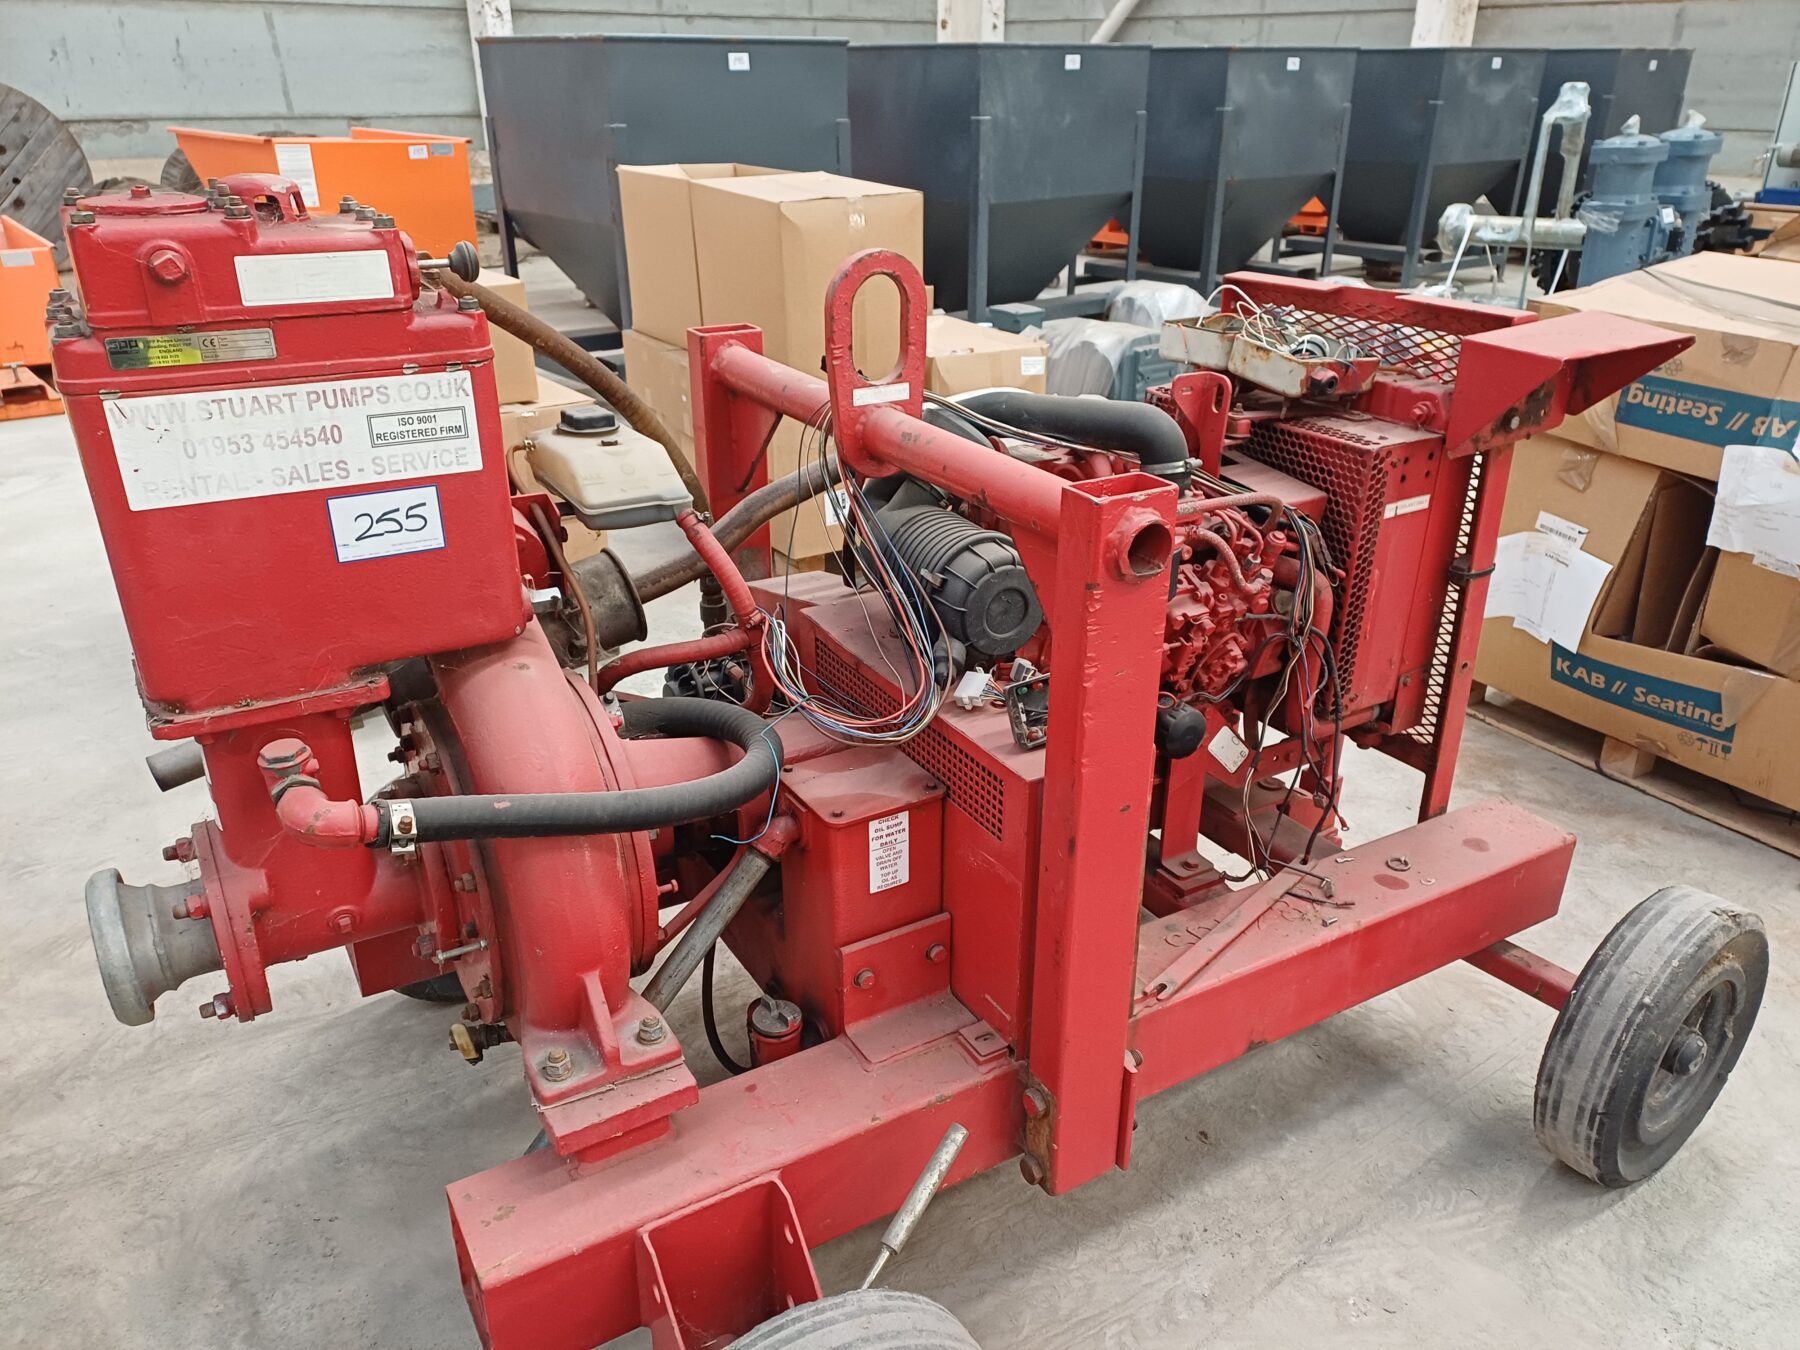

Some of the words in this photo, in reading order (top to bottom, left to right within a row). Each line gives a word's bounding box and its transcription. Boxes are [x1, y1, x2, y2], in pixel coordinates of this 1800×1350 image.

[1627, 383, 1723, 426] Seating
[398, 415, 413, 427] ISO
[416, 414, 438, 426] 9001
[376, 427, 437, 442] REGISTERED
[440, 424, 463, 437] FIRM
[183, 434, 255, 460] 01953
[262, 424, 343, 452] 454540
[142, 470, 253, 504] RENTAL
[273, 459, 351, 488] SALES
[372, 447, 469, 476] SERVICE
[353, 502, 428, 542] 255
[1556, 657, 1605, 690] KAB
[1633, 687, 1729, 731] Seating
[878, 814, 899, 825] CHECK
[886, 821, 903, 830] SUMP
[871, 834, 884, 842] FOR
[885, 828, 906, 838] WATER
[880, 838, 898, 847] DAILY
[883, 846, 897, 854] OPEN
[875, 853, 891, 861] VALVE
[876, 859, 892, 867] DRAIN
[880, 862, 898, 871] WATER
